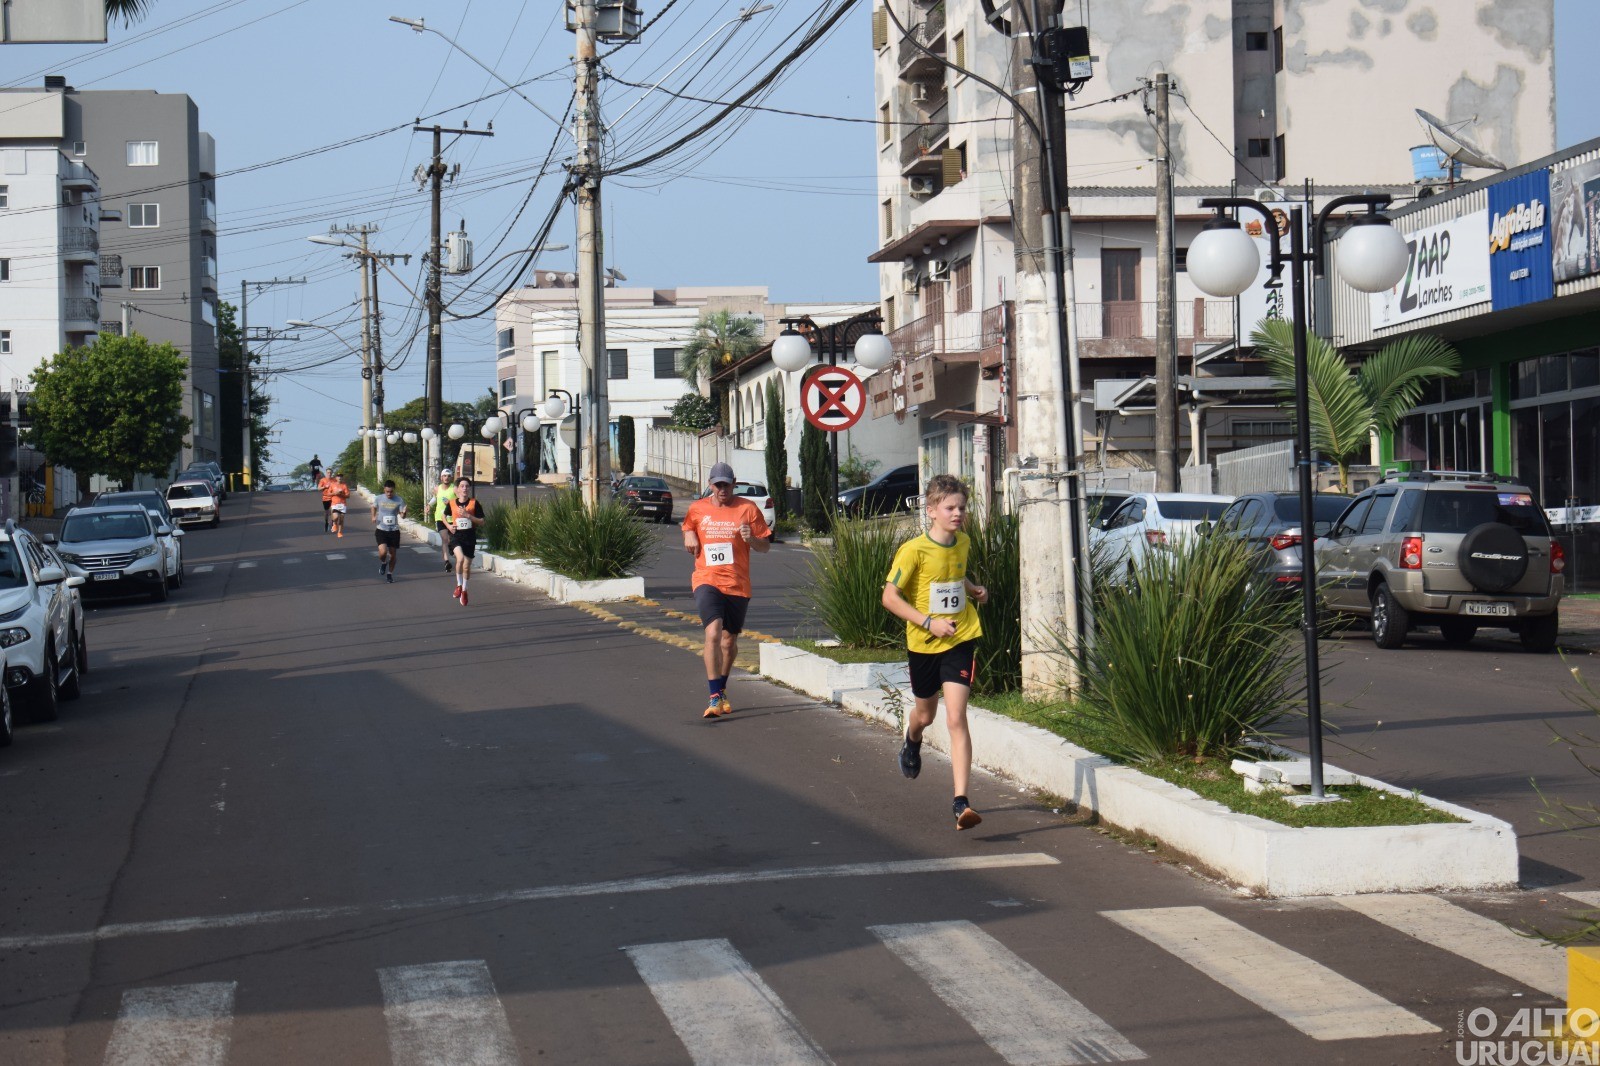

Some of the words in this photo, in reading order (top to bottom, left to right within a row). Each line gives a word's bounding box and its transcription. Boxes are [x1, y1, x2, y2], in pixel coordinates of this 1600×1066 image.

[1490, 199, 1545, 250] AgroBella
[1400, 230, 1451, 313] ZAAP
[1418, 280, 1453, 309] Lanches
[711, 552, 725, 562] 90
[941, 596, 959, 608] 19
